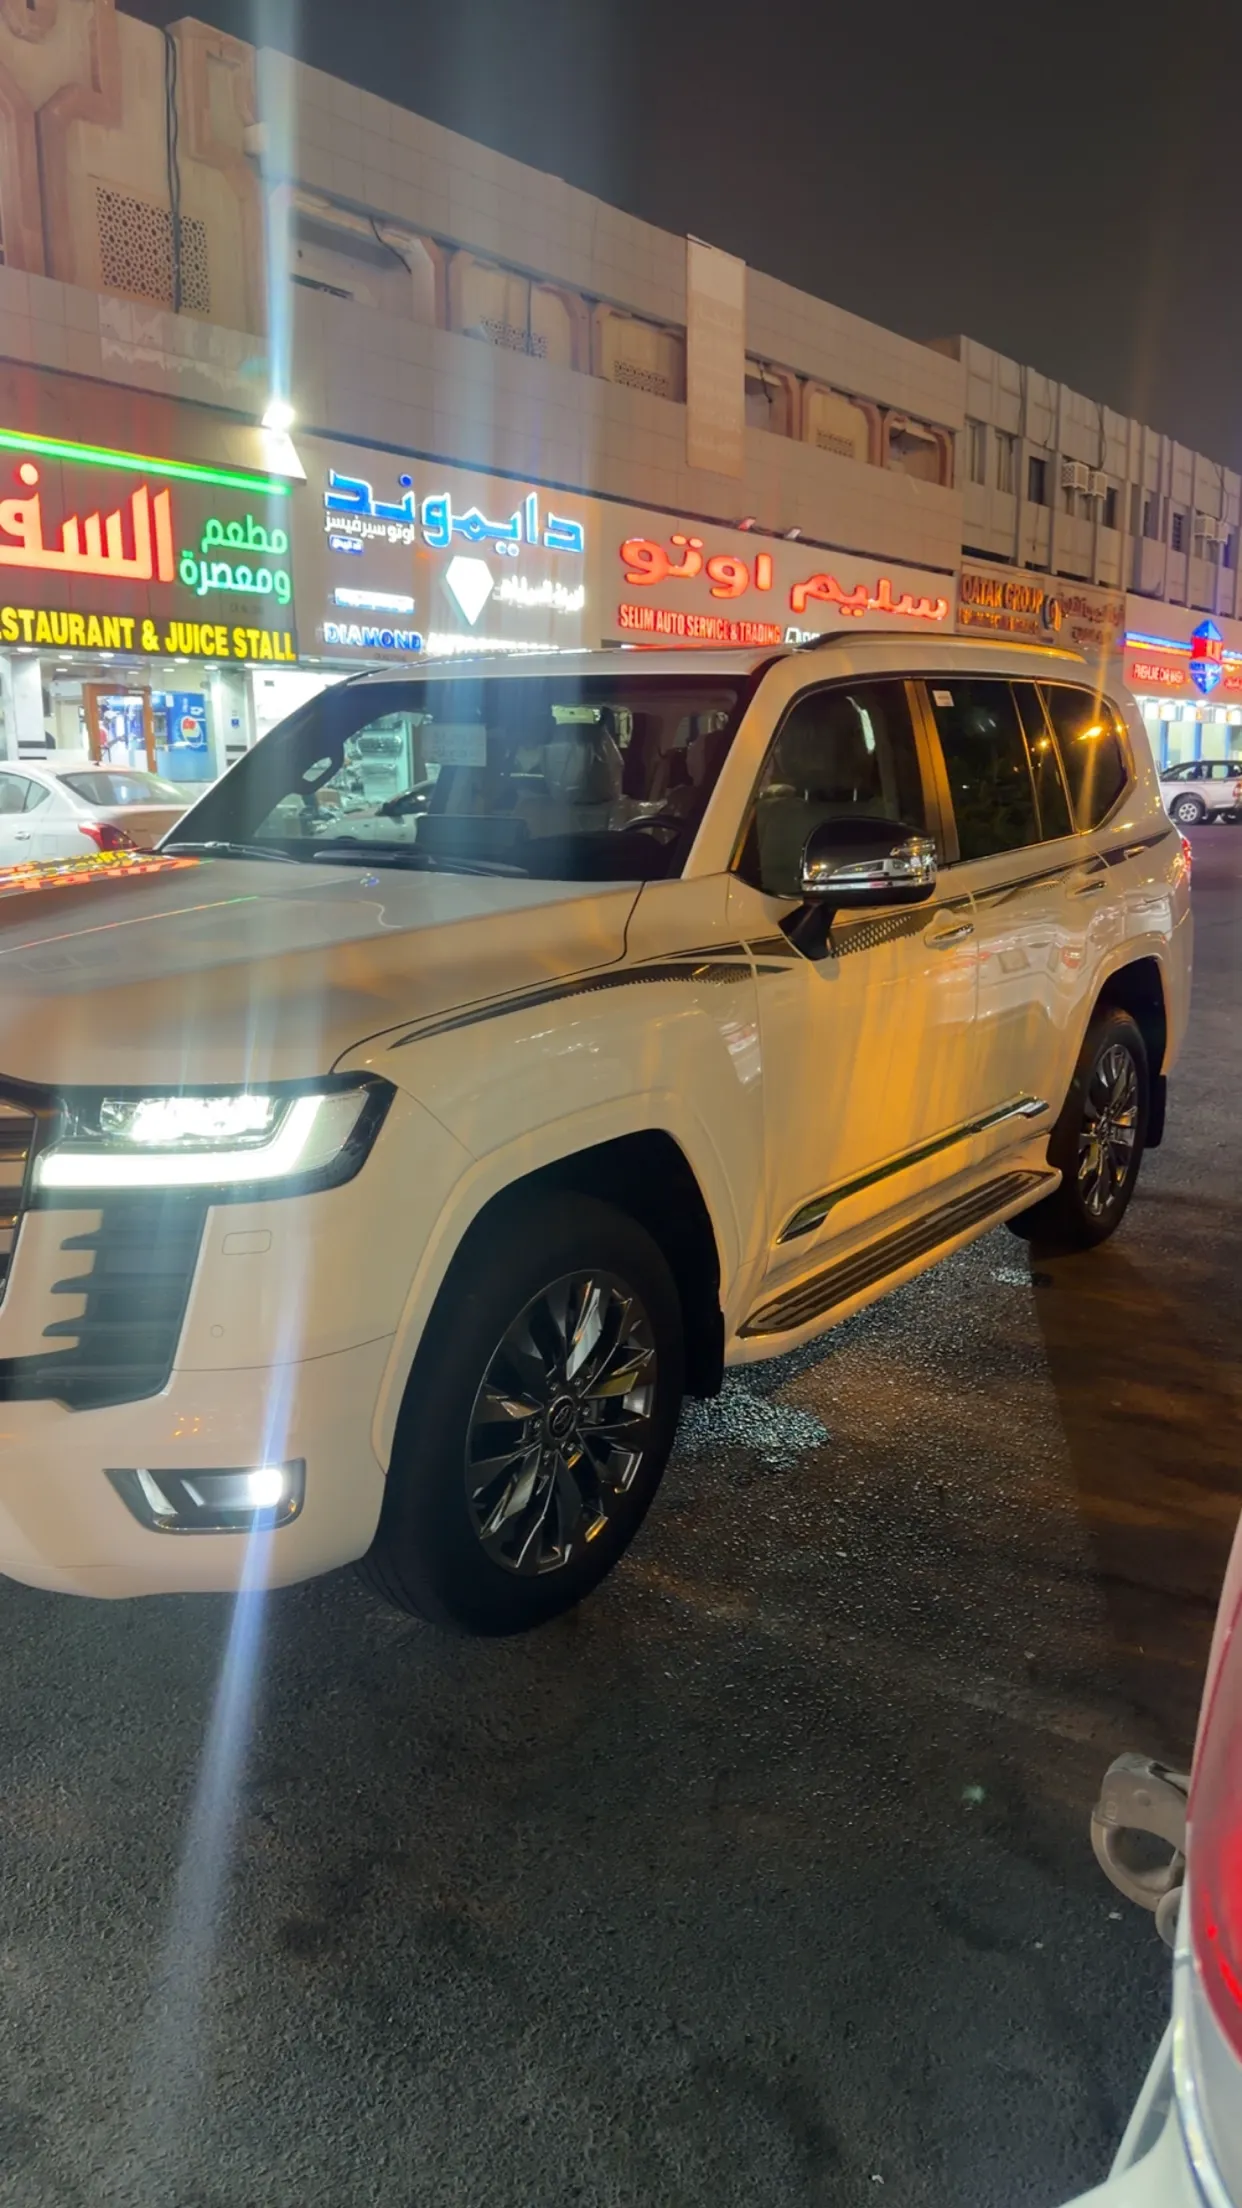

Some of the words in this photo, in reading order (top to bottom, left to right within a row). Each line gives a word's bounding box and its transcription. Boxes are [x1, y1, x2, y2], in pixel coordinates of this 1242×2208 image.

[201, 514, 288, 553] مطعم
[324, 468, 585, 557] دايموند
[180, 550, 292, 605] ومعصرة
[619, 533, 773, 599] اوتو
[790, 572, 949, 620] سليم
[961, 573, 1003, 606] QATAR
[1003, 582, 1044, 614] GROUP
[141, 619, 160, 652] &
[165, 622, 229, 658] JUICE
[232, 627, 297, 661] STALL
[323, 621, 424, 651] DIAMOND
[618, 603, 655, 630] SELIM
[655, 610, 686, 636] AUTO
[686, 614, 730, 641] SERVICE
[729, 623, 738, 641] &
[738, 621, 781, 645] TRADING
